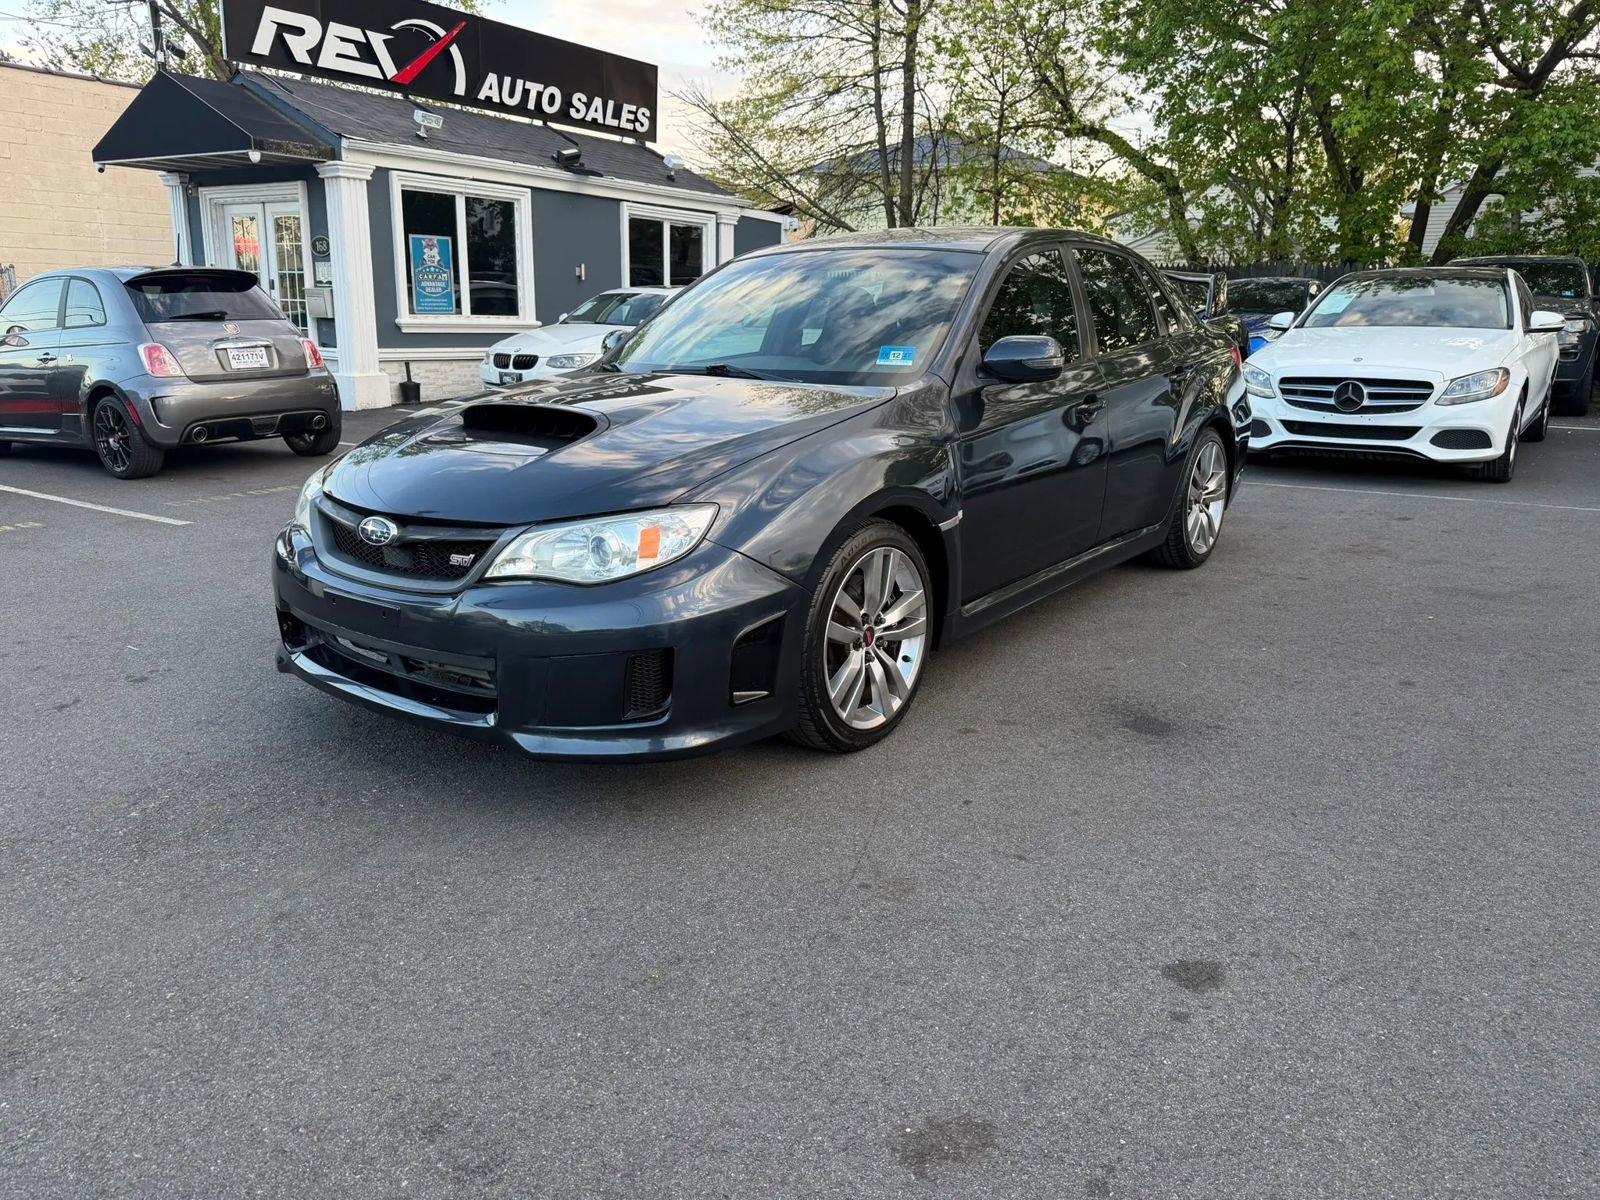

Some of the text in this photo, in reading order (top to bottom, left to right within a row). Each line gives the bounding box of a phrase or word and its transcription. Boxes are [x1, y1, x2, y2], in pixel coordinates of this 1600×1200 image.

[477, 72, 651, 134] AUTO SALES
[315, 240, 328, 252] 168
[231, 353, 264, 361] 421171V
